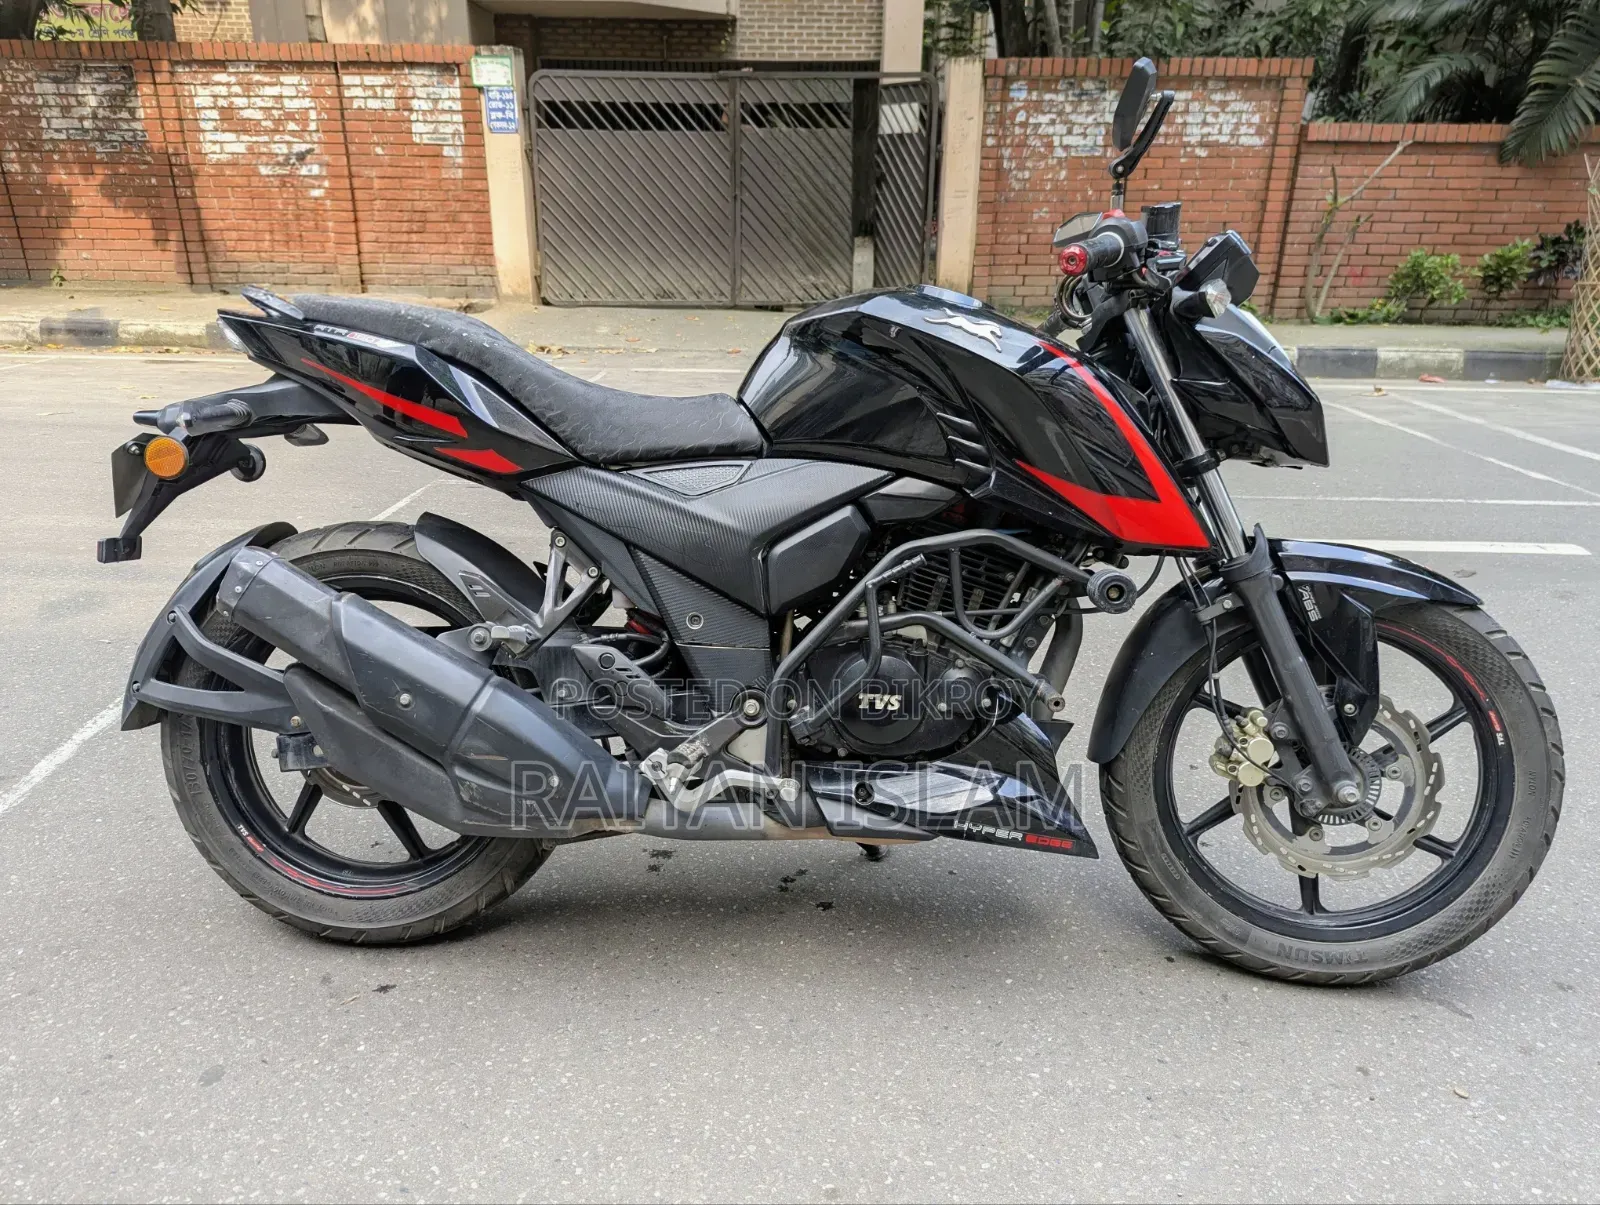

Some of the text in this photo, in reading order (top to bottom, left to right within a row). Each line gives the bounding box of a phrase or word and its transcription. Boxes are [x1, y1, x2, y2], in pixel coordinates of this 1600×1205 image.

[1298, 588, 1319, 622] ABS
[858, 693, 902, 711] TVS
[1496, 732, 1505, 746] TVS
[1527, 770, 1537, 797] NYLON
[237, 824, 249, 836] TVS
[954, 820, 1024, 841] HYPER
[1276, 942, 1369, 965] TIMSUN
